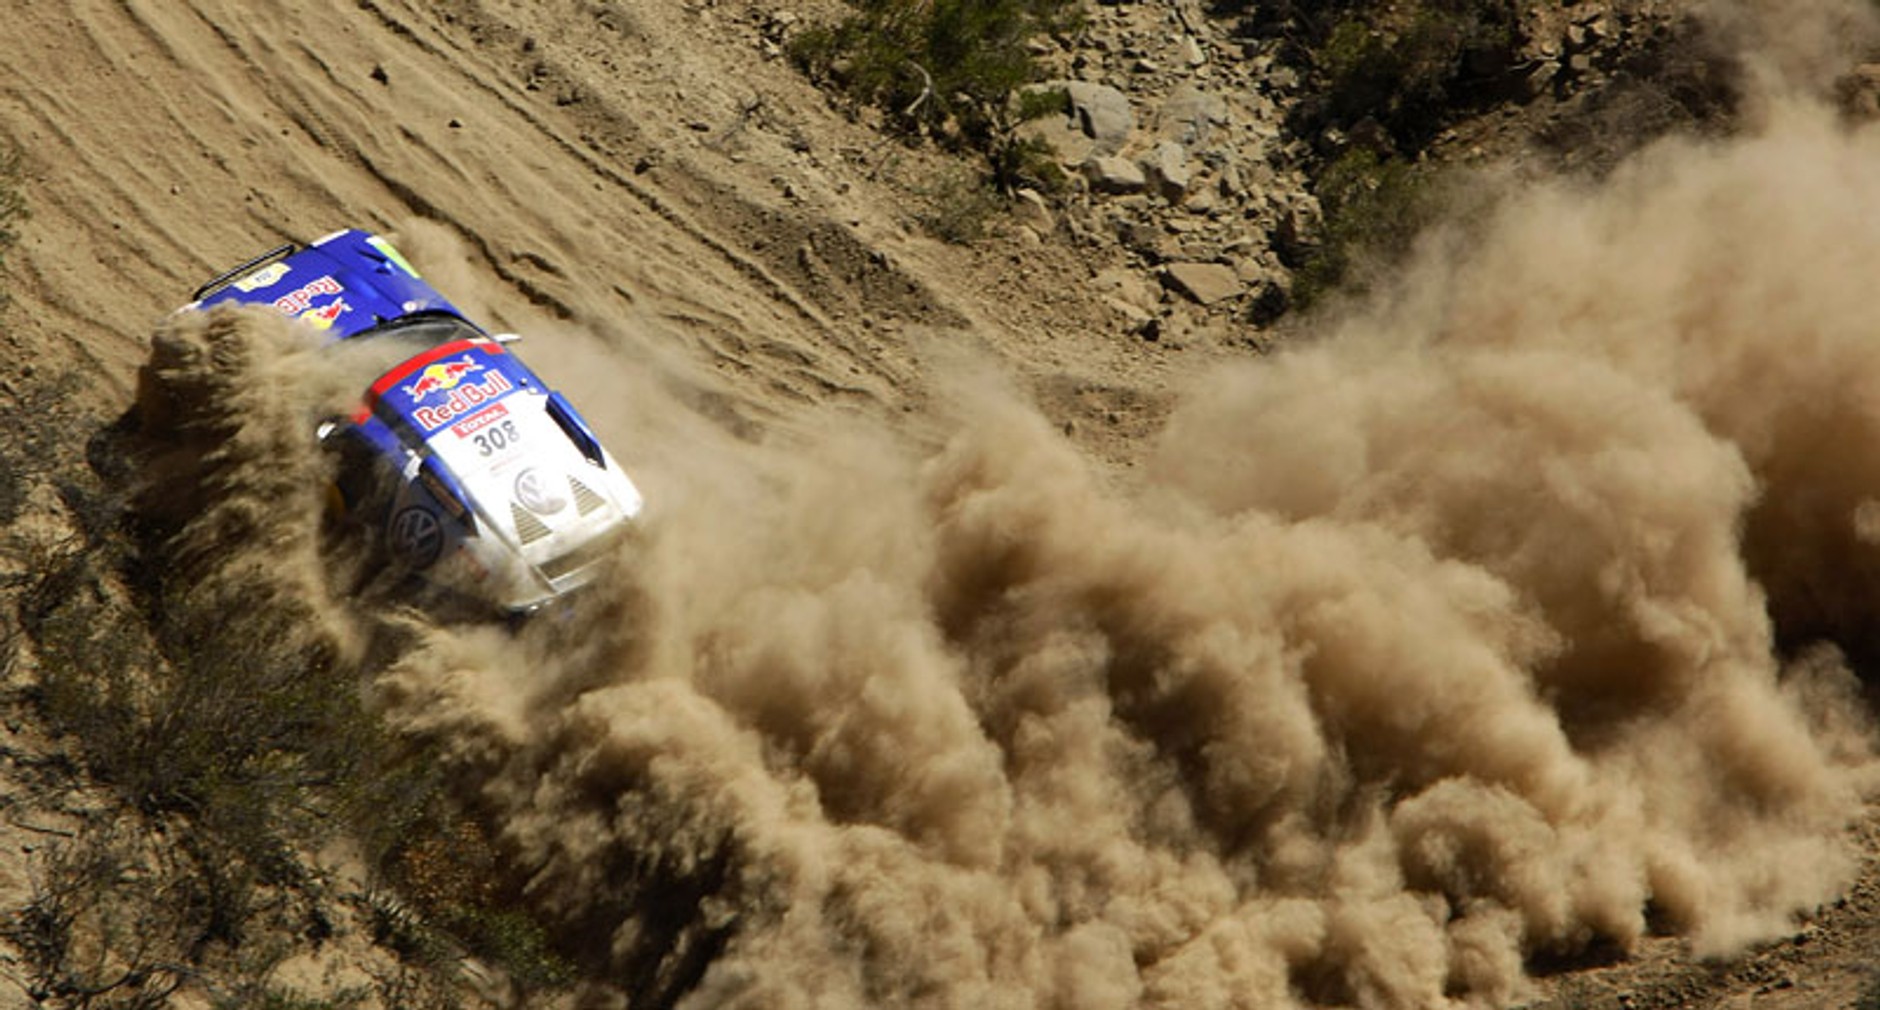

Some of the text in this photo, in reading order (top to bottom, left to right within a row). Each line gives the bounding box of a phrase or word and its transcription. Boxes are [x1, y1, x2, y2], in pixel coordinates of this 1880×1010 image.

[293, 276, 343, 308] Red
[413, 369, 512, 430] Red Bull
[473, 420, 519, 457] 308
